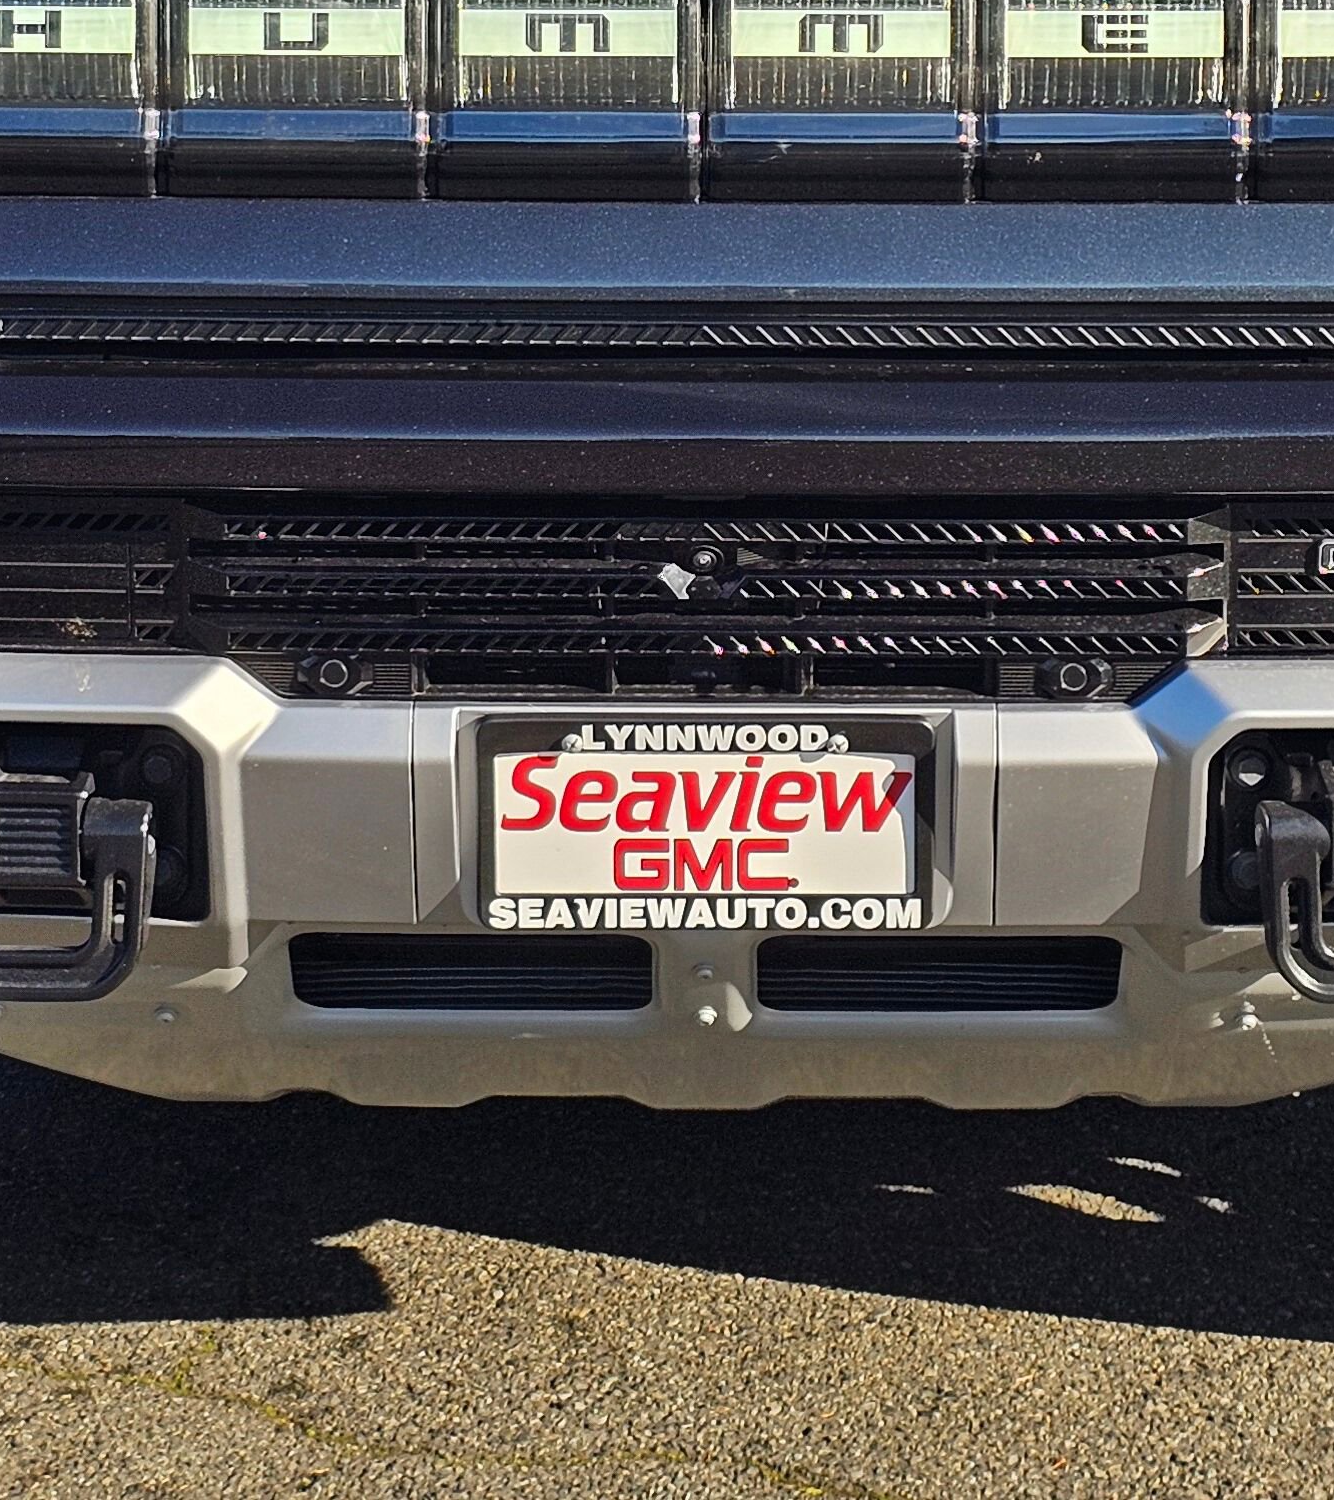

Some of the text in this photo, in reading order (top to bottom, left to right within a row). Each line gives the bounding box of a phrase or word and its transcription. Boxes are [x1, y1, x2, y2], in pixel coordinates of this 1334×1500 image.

[582, 723, 830, 752] LYNNWOOD
[500, 755, 913, 833] Seaview
[613, 838, 791, 891] GMC
[488, 896, 923, 931] SEAVIEWAUTO.COM
